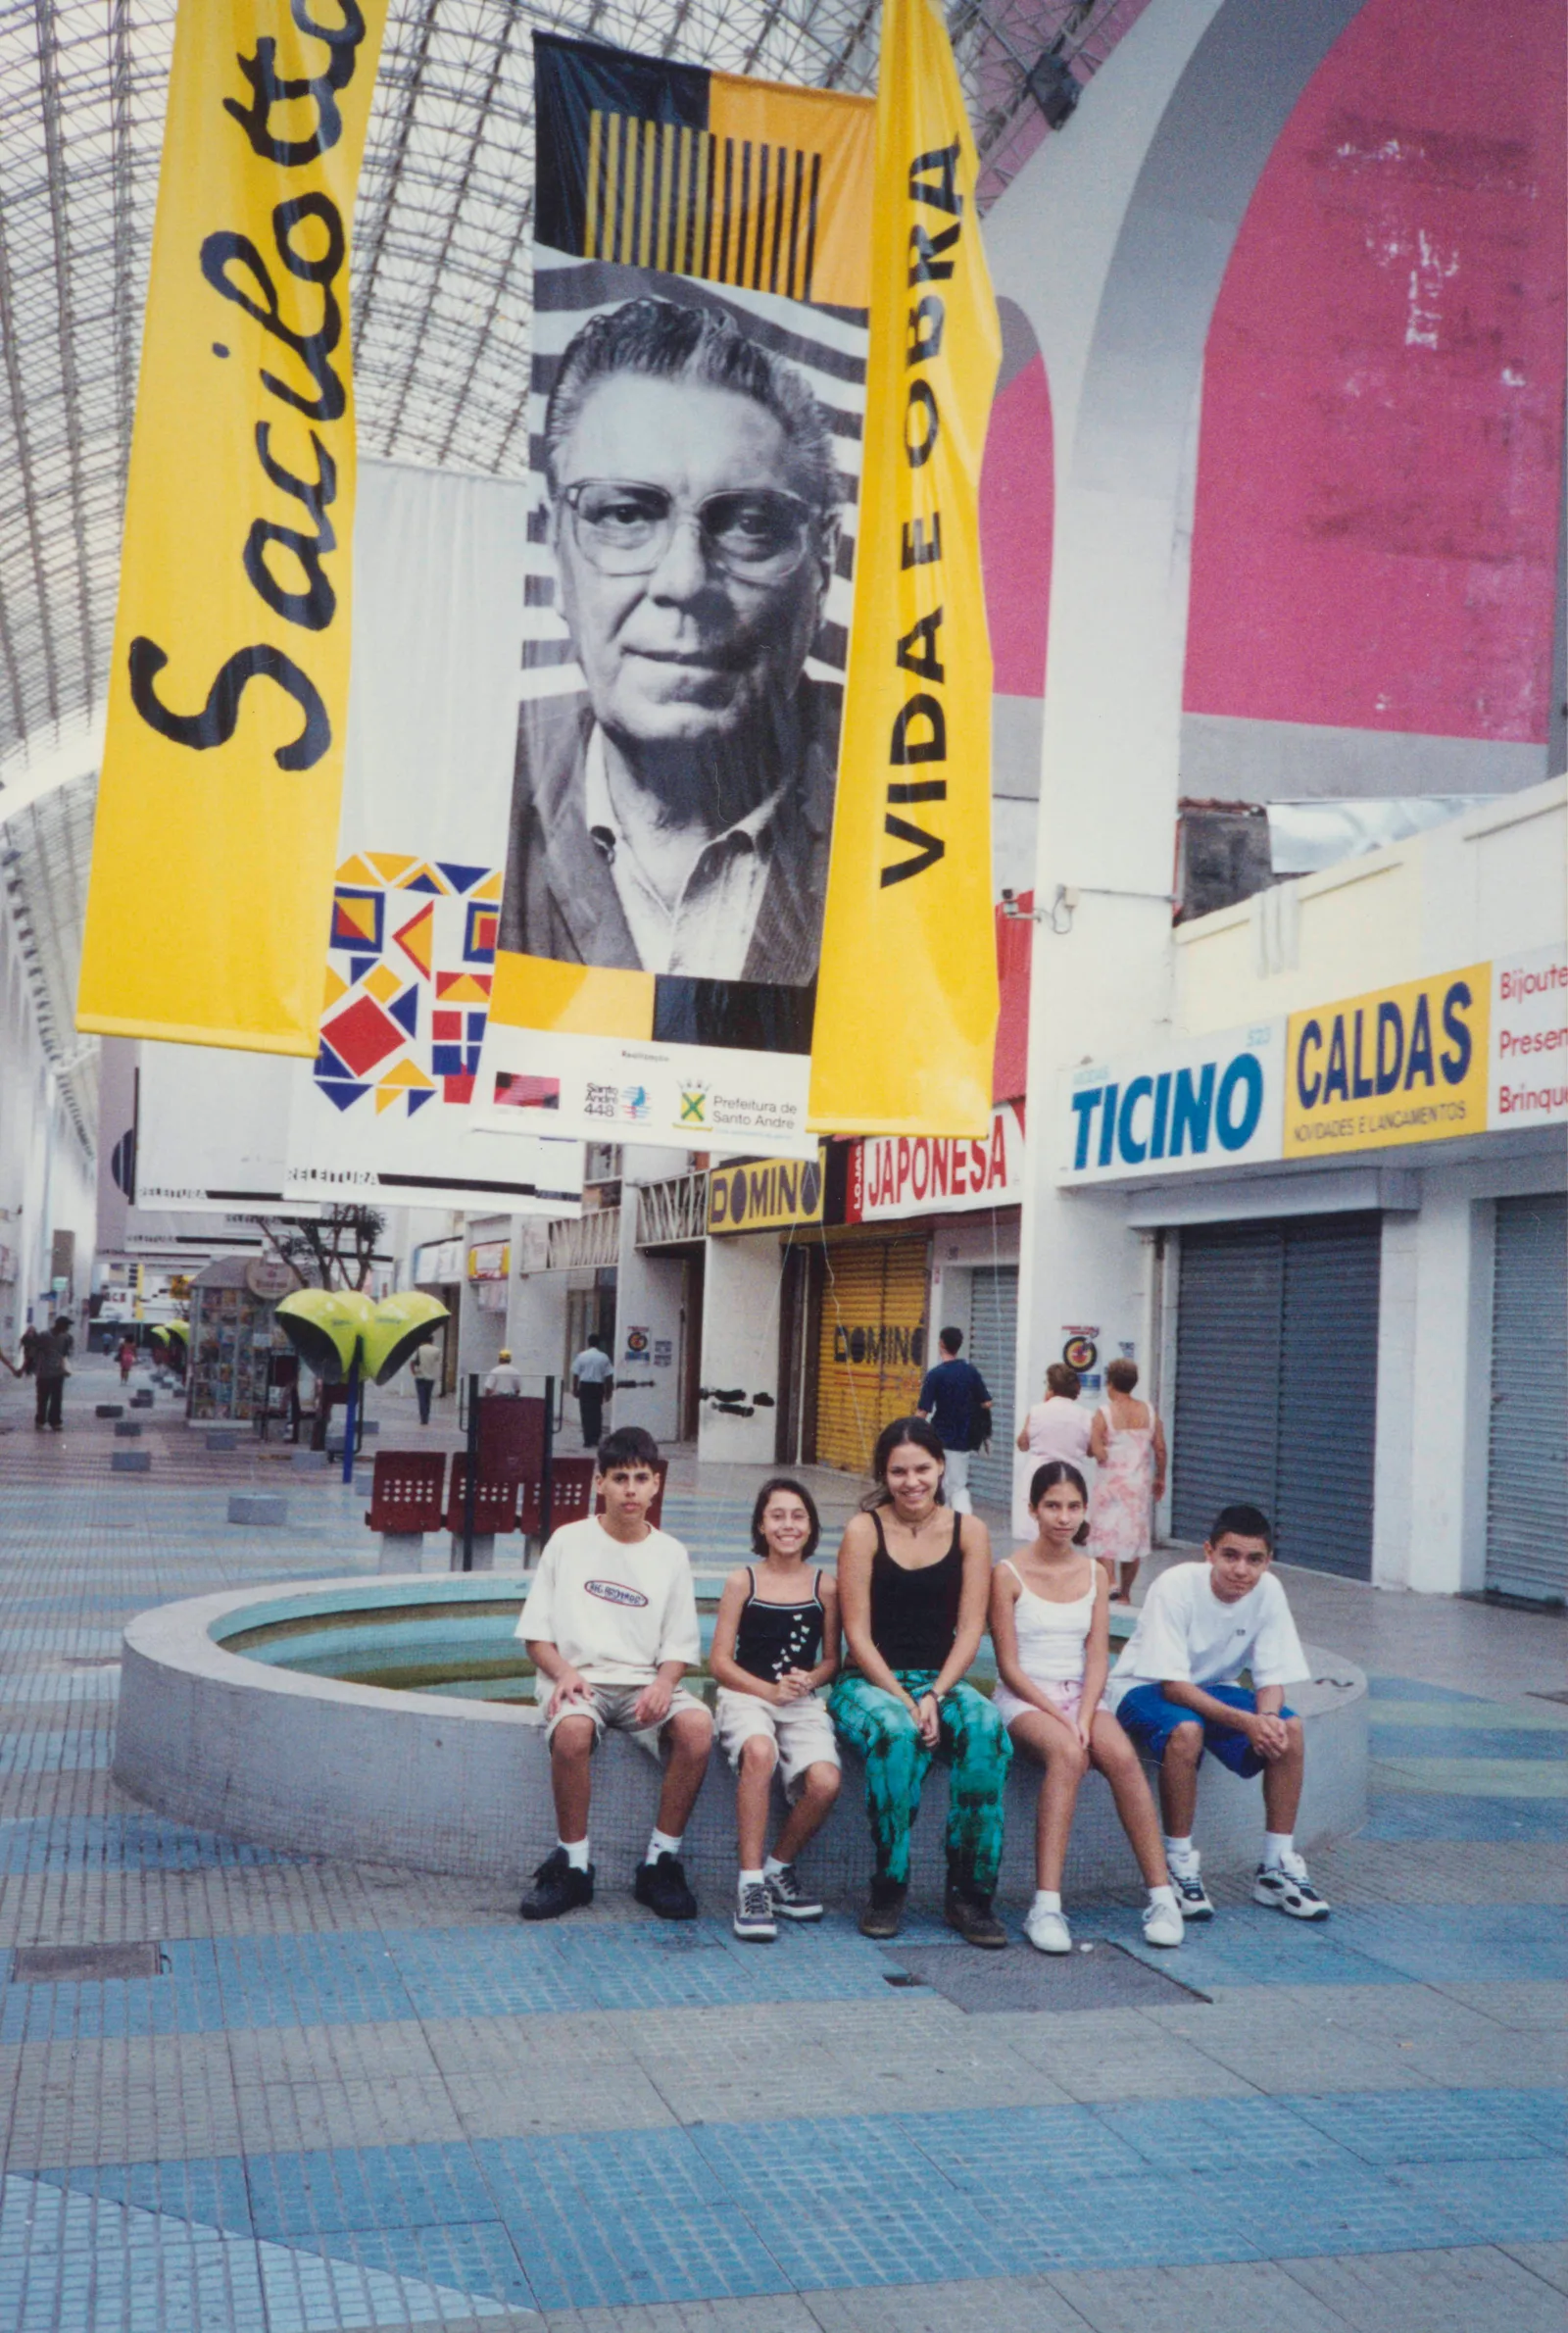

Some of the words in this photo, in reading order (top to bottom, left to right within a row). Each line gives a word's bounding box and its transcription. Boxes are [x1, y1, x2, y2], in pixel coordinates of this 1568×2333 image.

[904, 130, 963, 470] OBRA
[900, 511, 942, 571] E
[880, 604, 947, 889] VIDA
[1297, 980, 1473, 1110] CALDAS
[584, 1103, 615, 1117] 448
[712, 1111, 752, 1126] Santo
[713, 1095, 777, 1114] Prefeitura
[780, 1102, 798, 1115] de
[1071, 1052, 1264, 1170] TICINO
[1498, 1081, 1568, 1115] Brinqu
[1294, 1117, 1354, 1142] NOVIDADES
[1358, 1117, 1365, 1133] E
[854, 1144, 862, 1210] LOJAS
[868, 1115, 1007, 1207] JAPONESA
[710, 1161, 822, 1225] DOMINO
[834, 1324, 926, 1367] DOMINO
